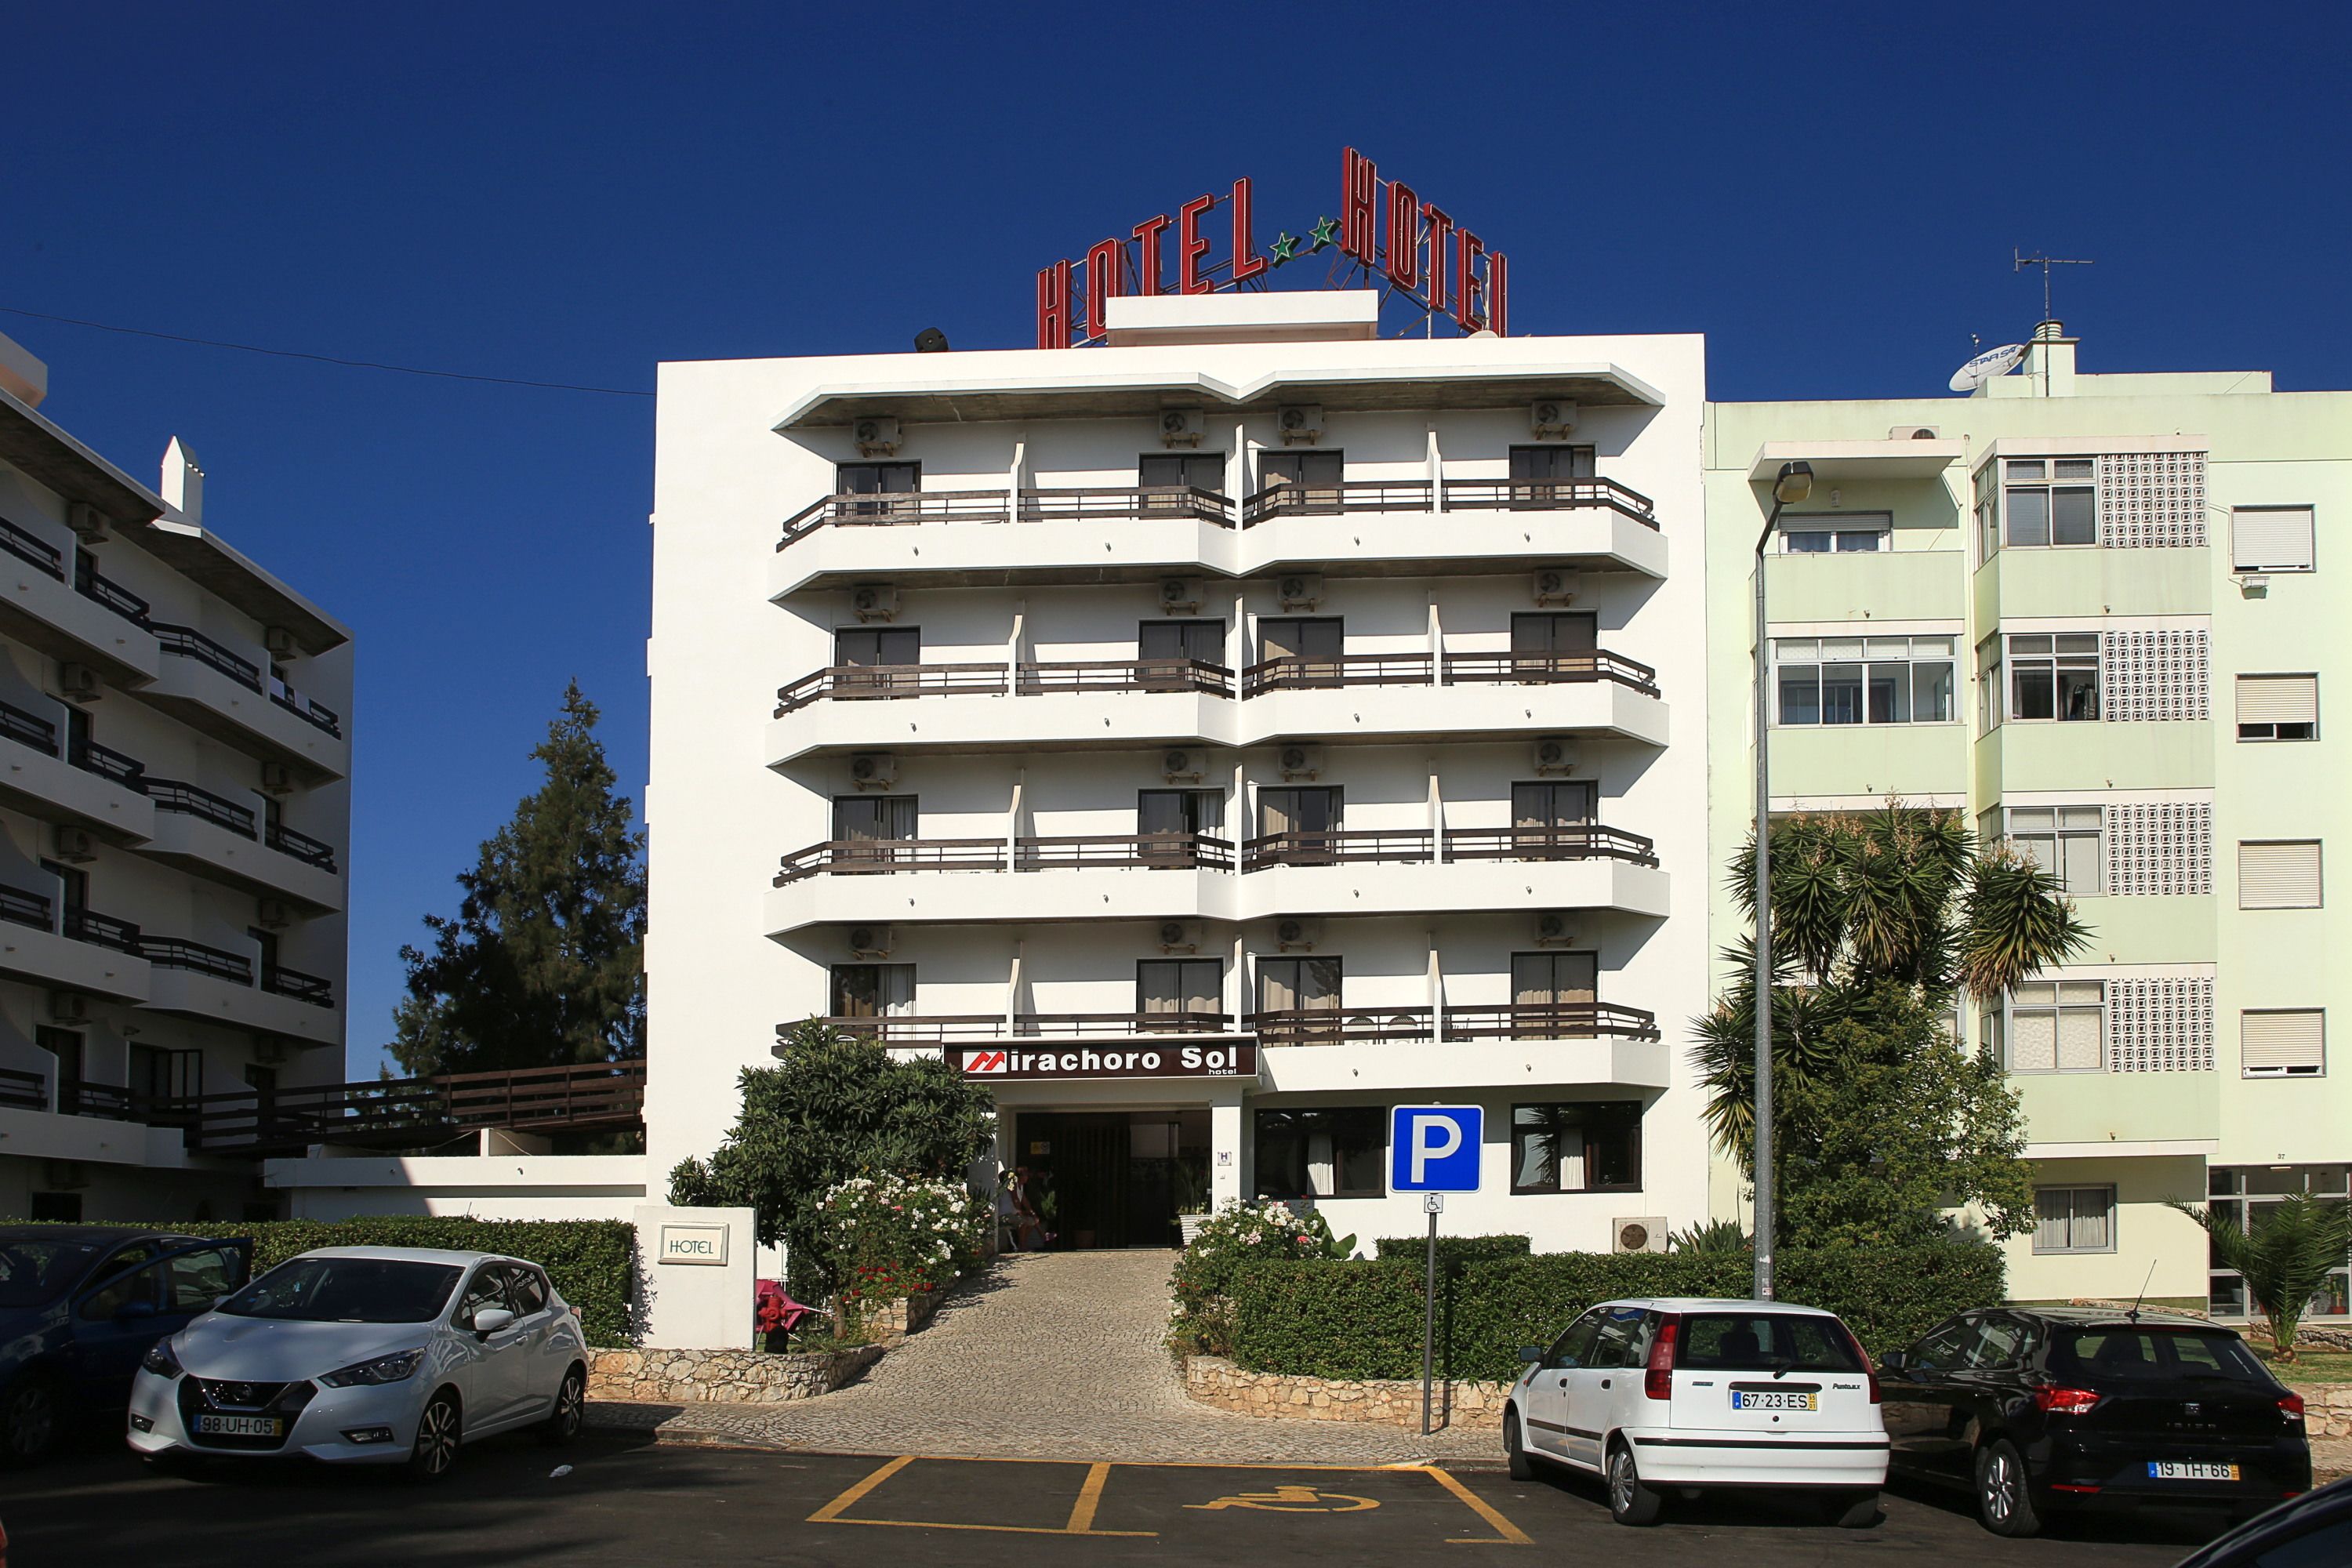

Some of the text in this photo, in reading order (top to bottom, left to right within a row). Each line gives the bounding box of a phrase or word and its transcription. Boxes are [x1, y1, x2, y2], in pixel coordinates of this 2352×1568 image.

[1036, 176, 1269, 350] HOTEL
[1181, 1045, 1237, 1069] Sol
[1410, 1115, 1462, 1183] P
[670, 1240, 714, 1254] HOTEL
